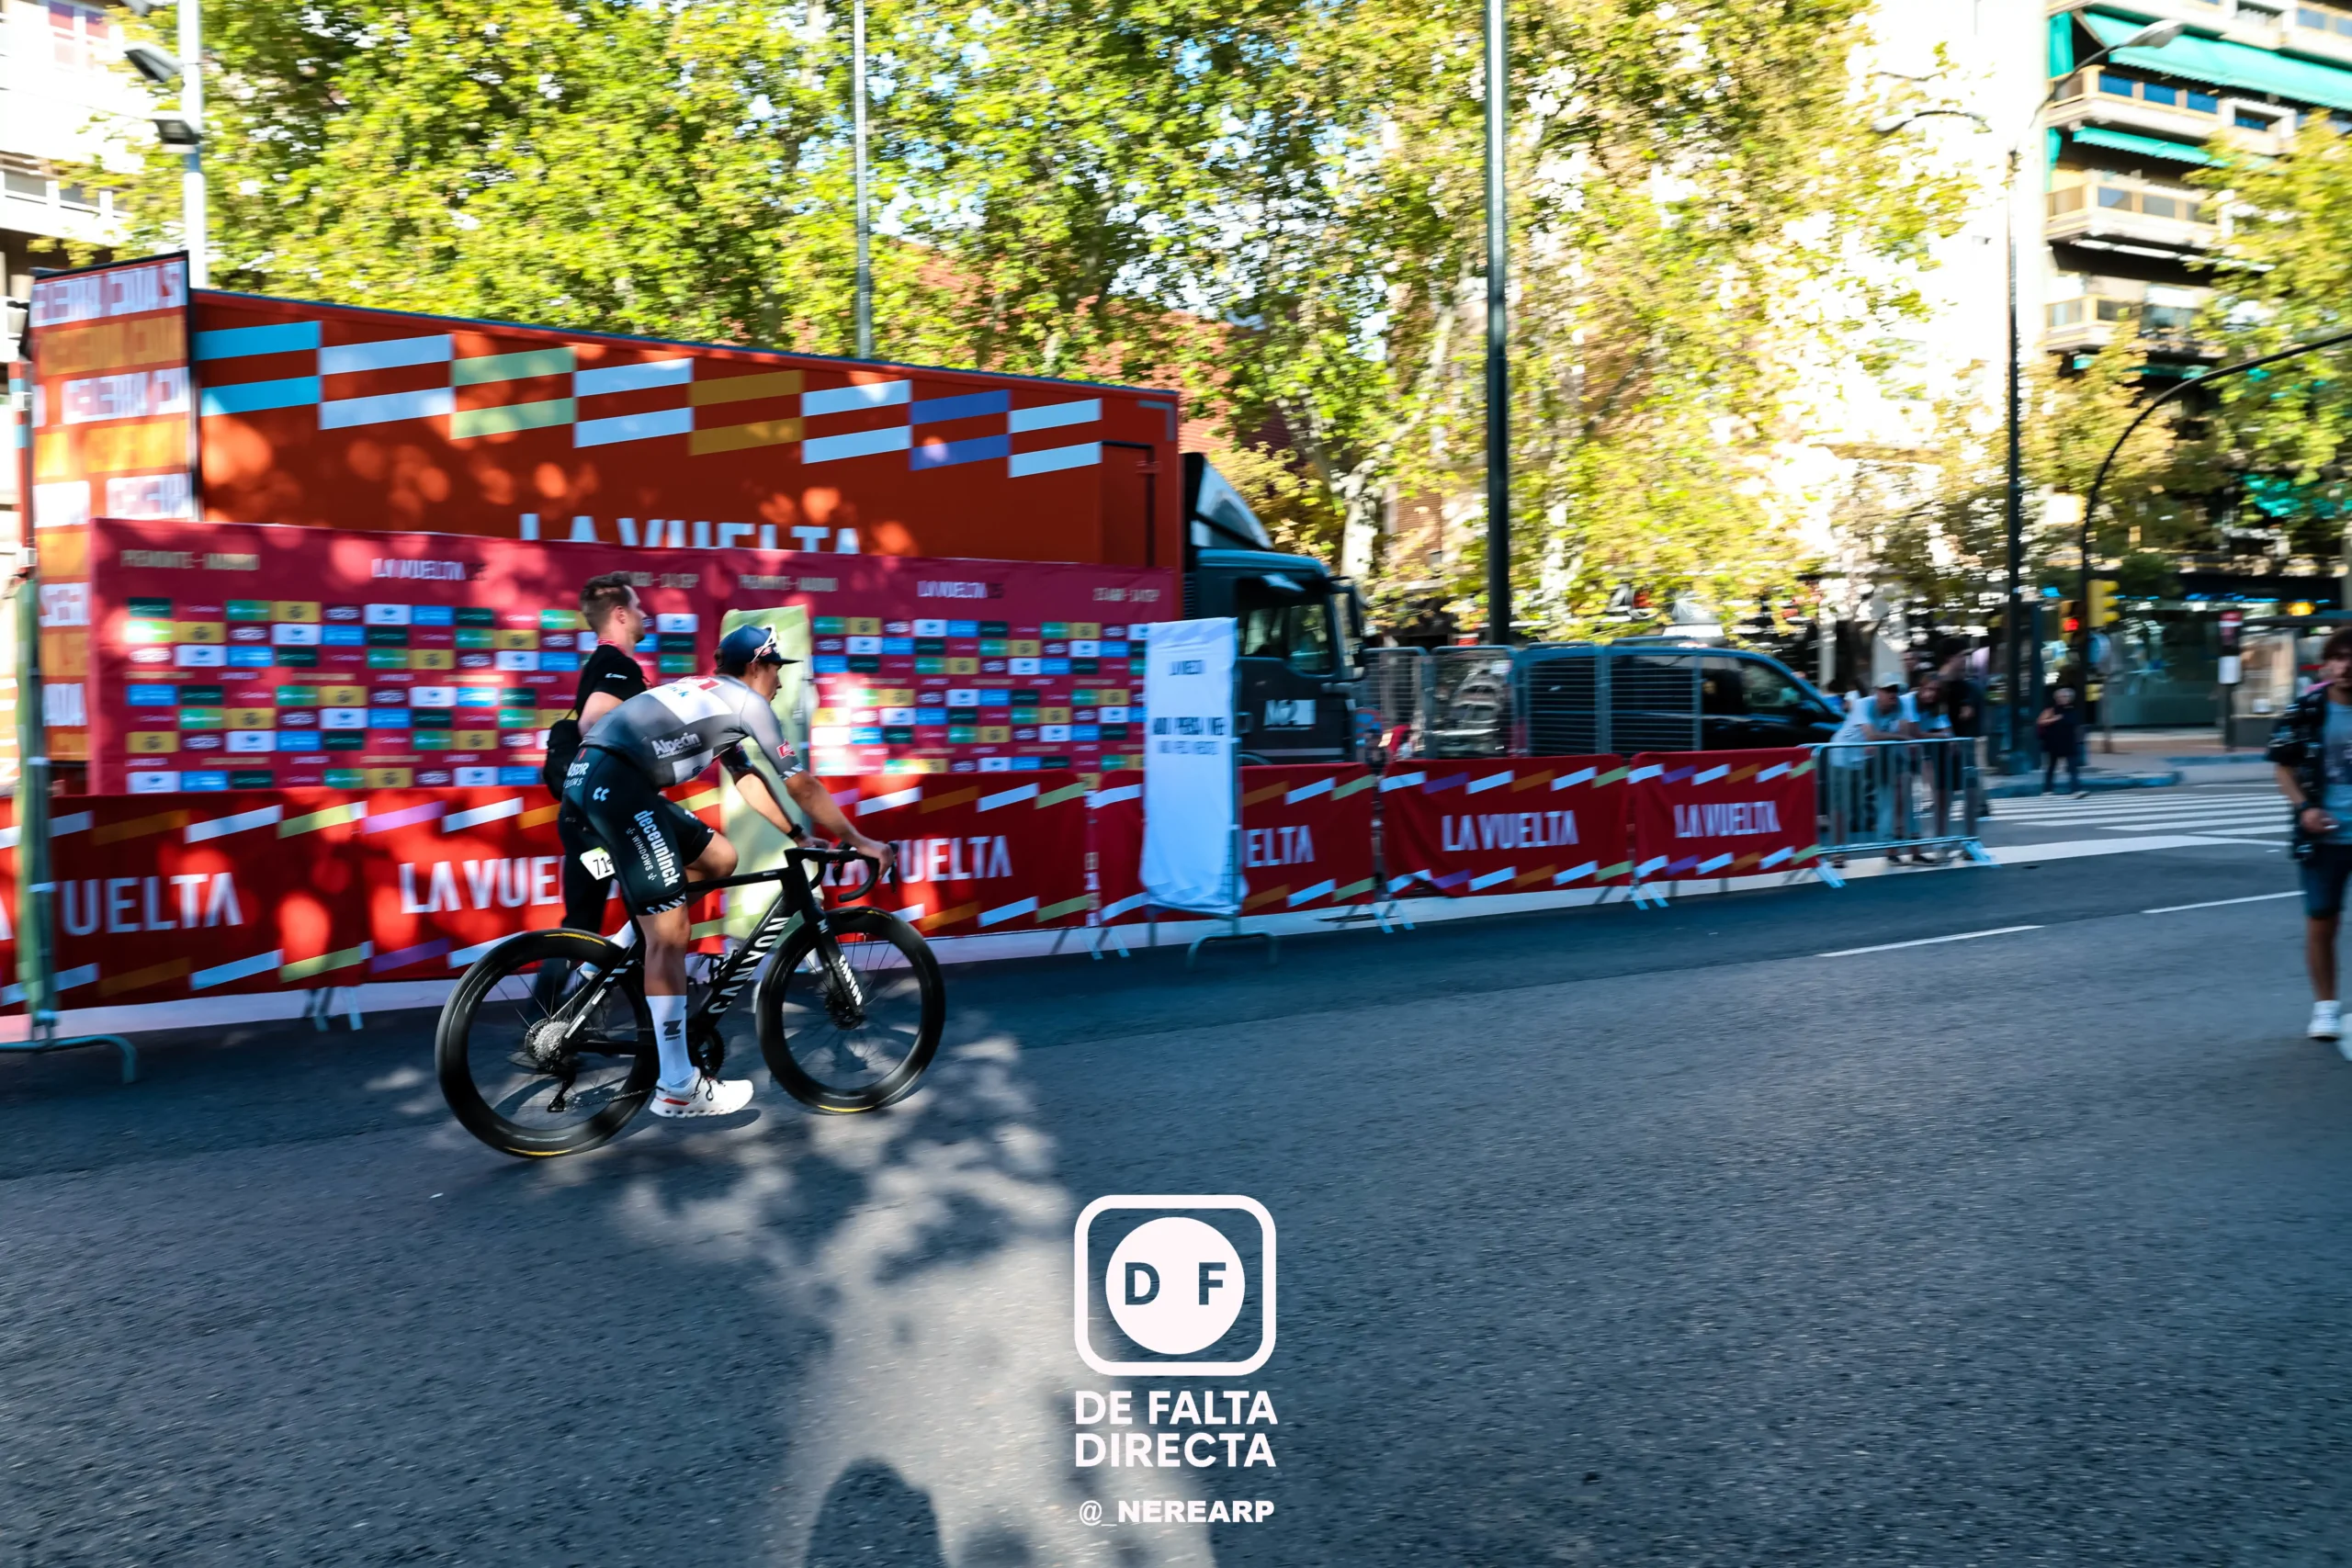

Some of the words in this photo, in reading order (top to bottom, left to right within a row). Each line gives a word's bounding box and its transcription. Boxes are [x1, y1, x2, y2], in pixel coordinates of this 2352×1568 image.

[651, 732, 701, 756] Alpecin
[1442, 812, 1477, 852] LA
[1477, 809, 1579, 851] VUELTA
[1673, 805, 1702, 839] LA
[1701, 801, 1782, 838] VUELTA
[632, 835, 654, 873] WINDOWS
[634, 810, 681, 887] deceuninck
[1246, 825, 1316, 868] ELTA
[61, 872, 243, 936] UELTA
[399, 861, 462, 914] LA
[461, 855, 566, 910] VUE
[707, 917, 789, 1014] CANYON
[838, 953, 864, 1007] CANYON
